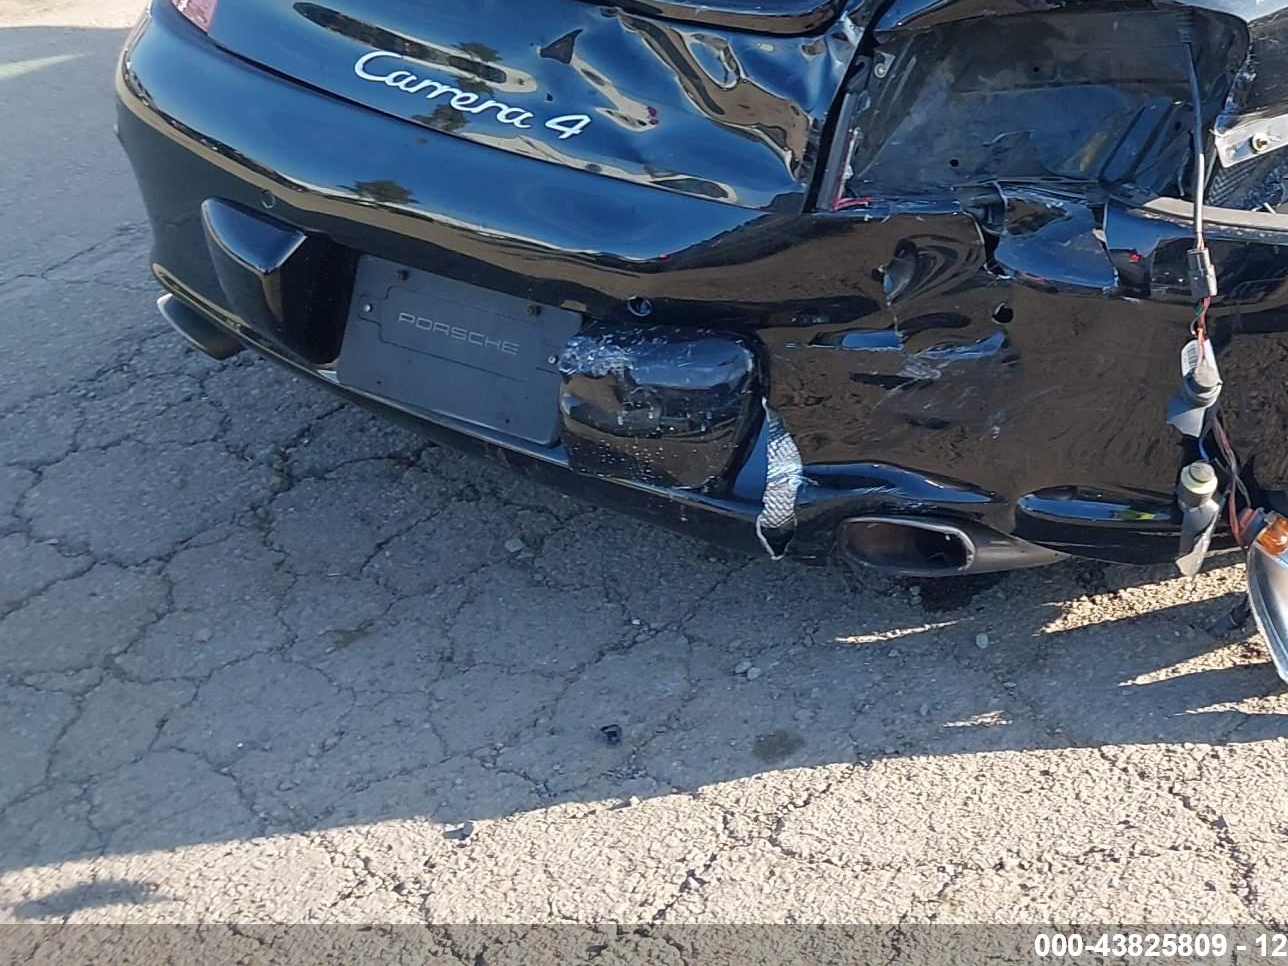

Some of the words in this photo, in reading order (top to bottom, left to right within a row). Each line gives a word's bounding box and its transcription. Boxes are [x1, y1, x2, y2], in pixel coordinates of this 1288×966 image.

[354, 50, 533, 129] Carrera
[544, 114, 592, 139] 4
[398, 312, 521, 356] PORSCHE
